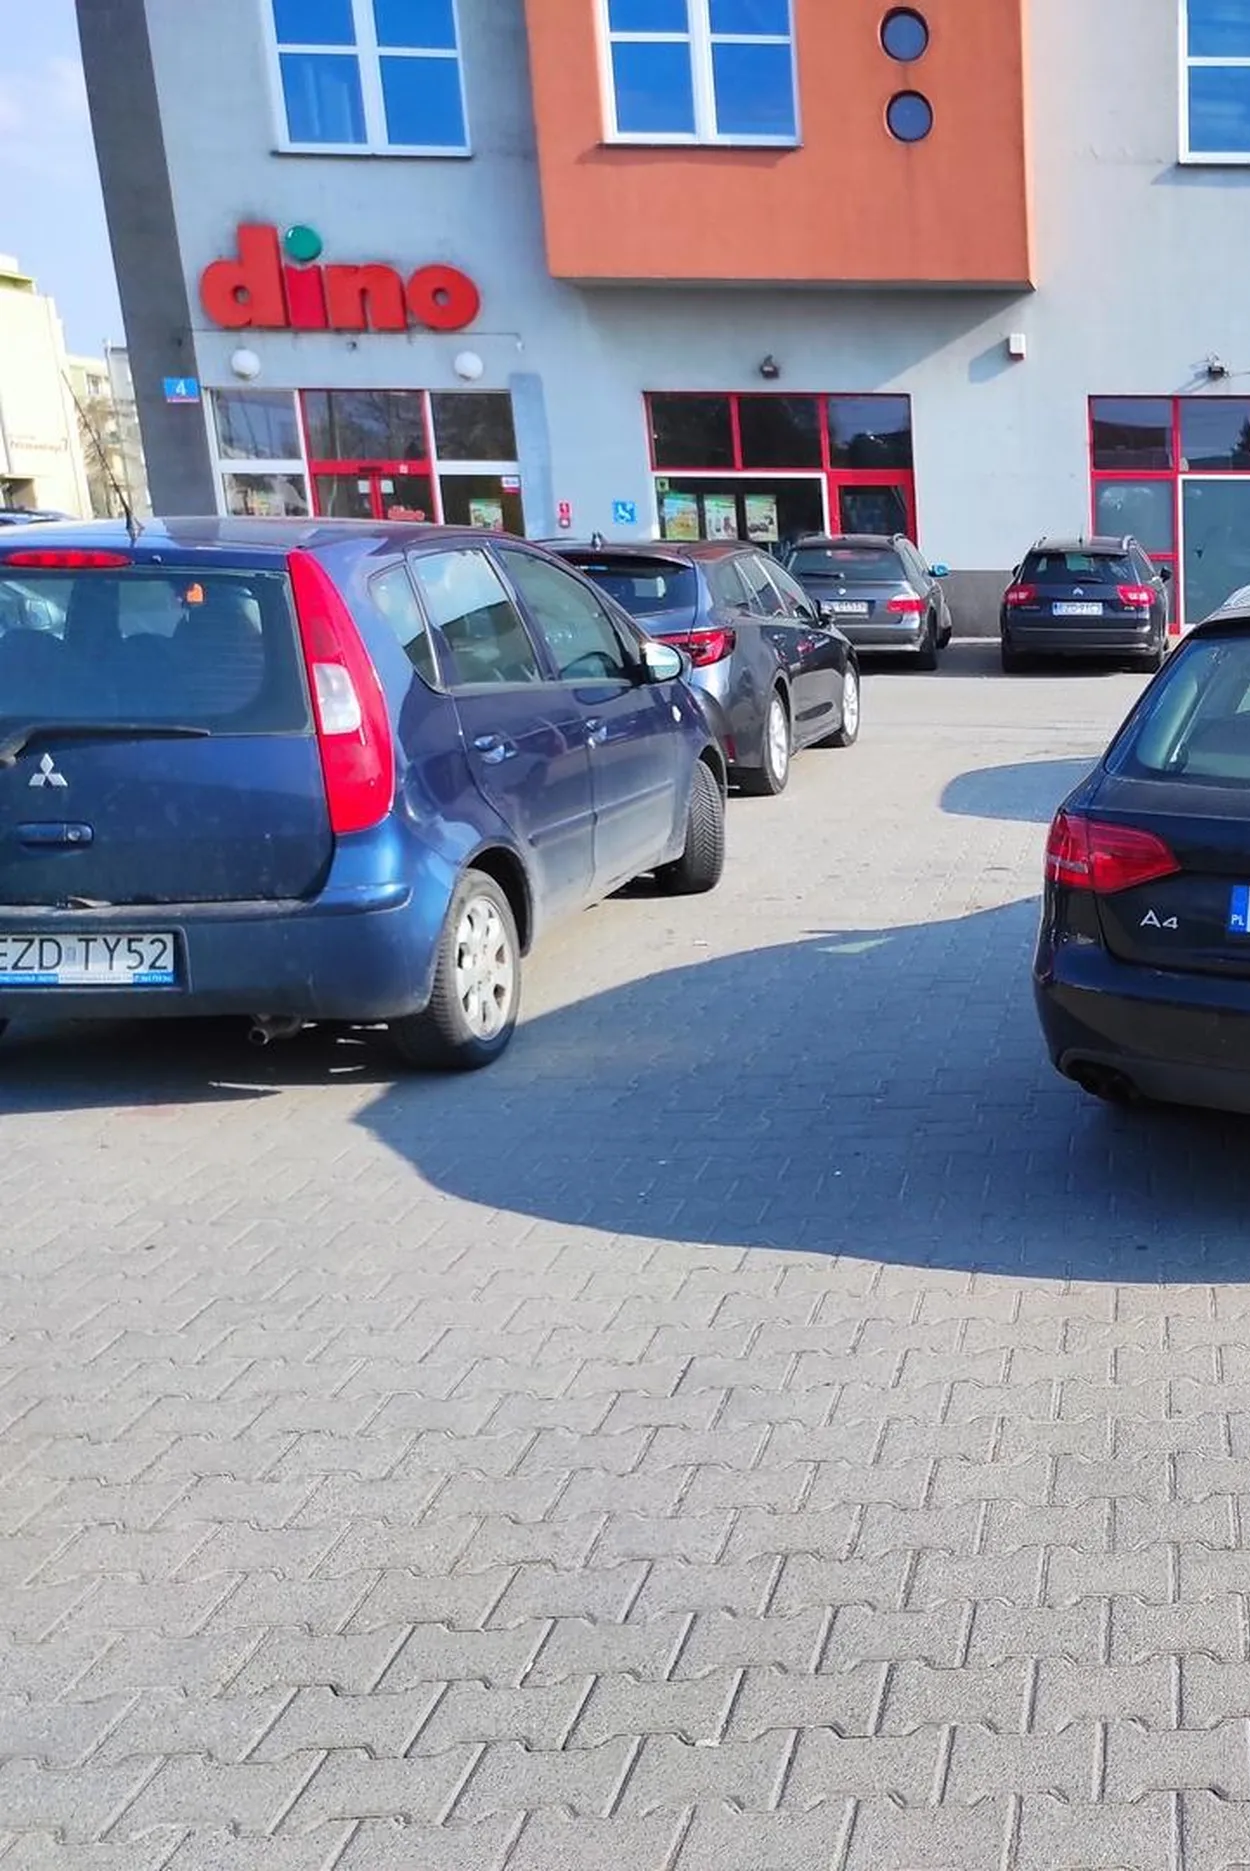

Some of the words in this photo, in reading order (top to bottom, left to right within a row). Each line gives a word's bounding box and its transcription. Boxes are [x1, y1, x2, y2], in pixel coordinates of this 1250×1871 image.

[201, 223, 480, 331] dino
[175, 379, 187, 396] 4
[1139, 908, 1179, 930] A4
[1230, 914, 1245, 926] PL
[77, 936, 168, 971] TY52
